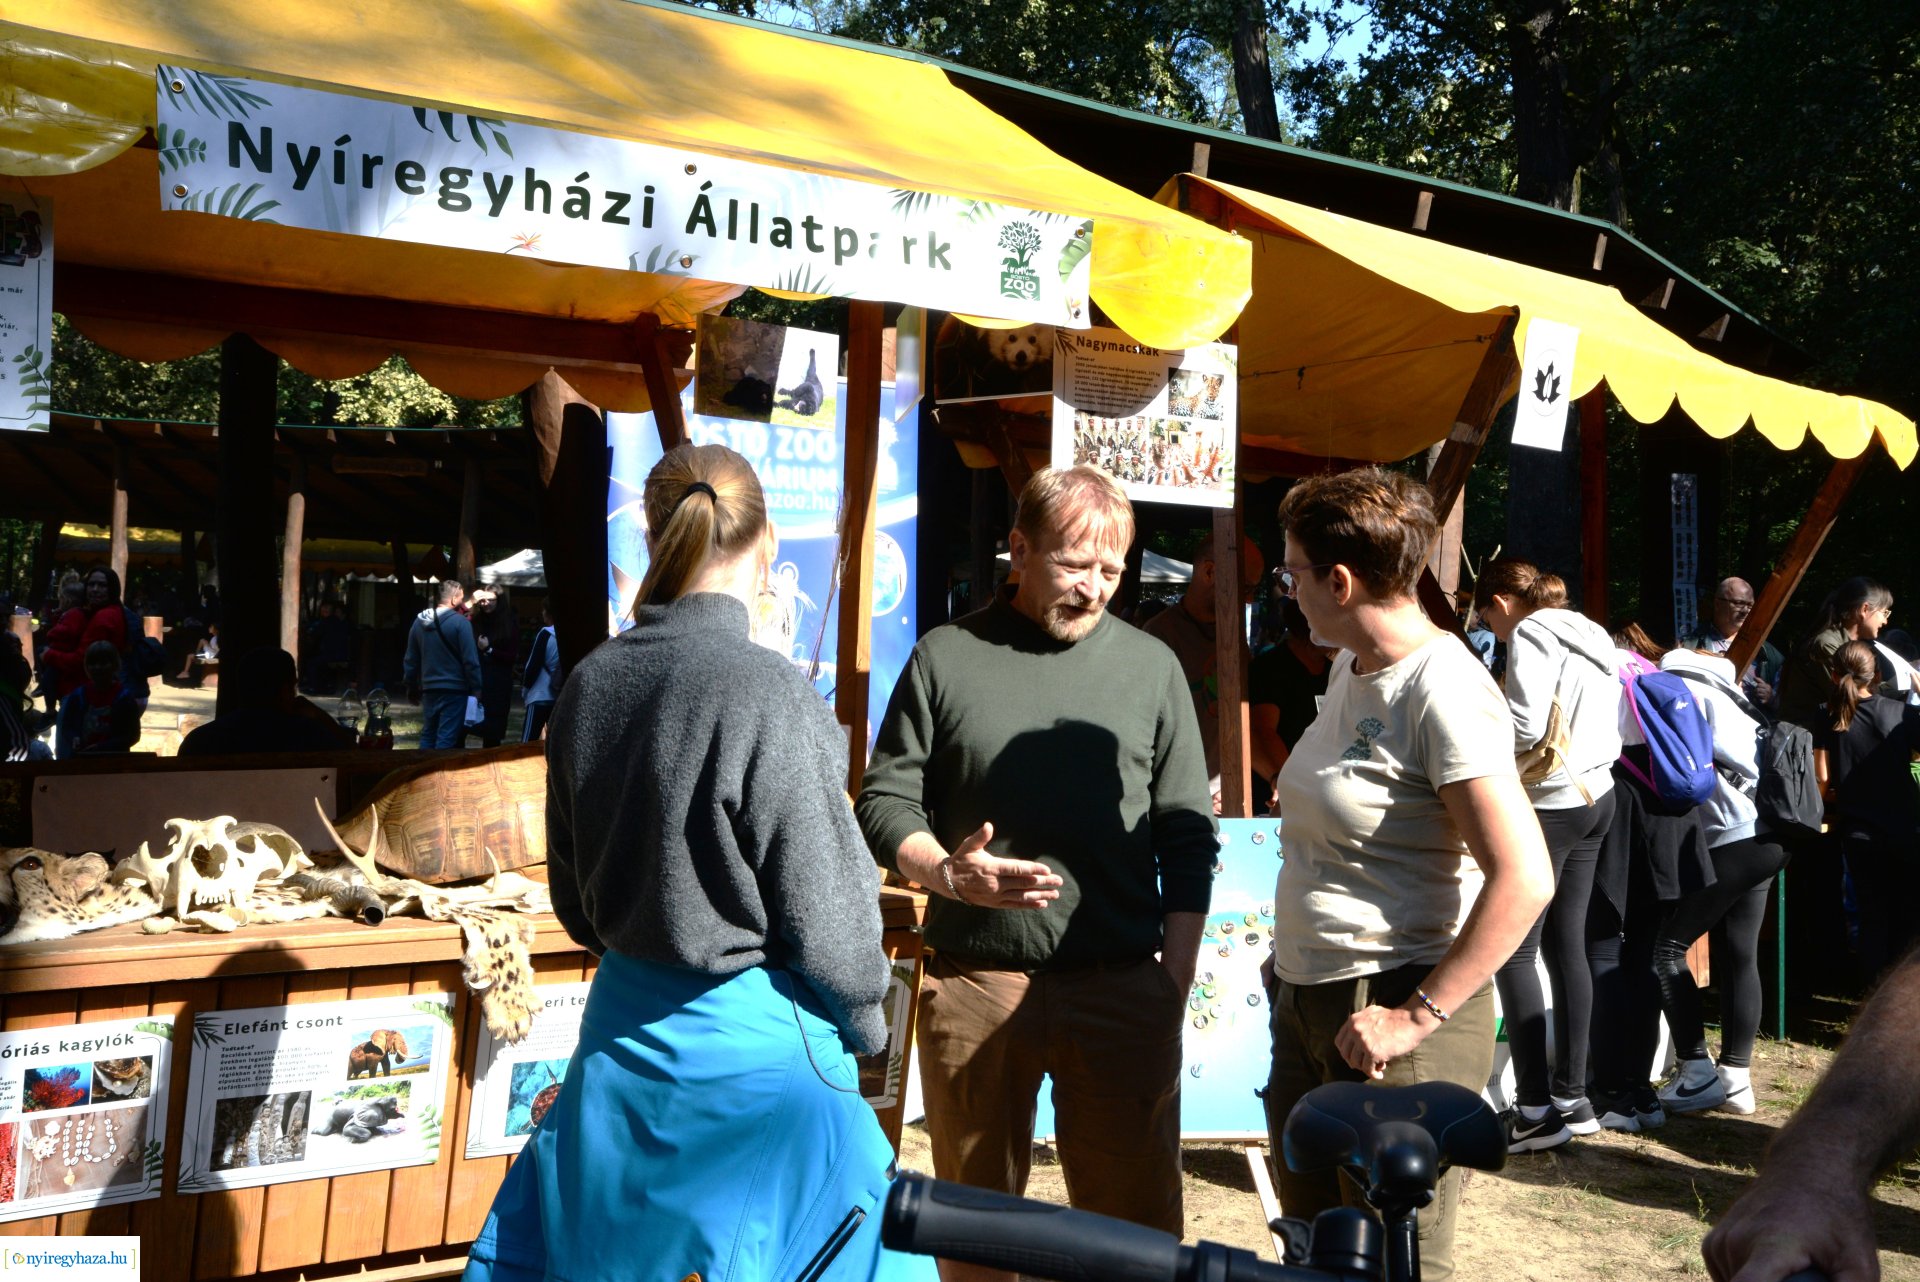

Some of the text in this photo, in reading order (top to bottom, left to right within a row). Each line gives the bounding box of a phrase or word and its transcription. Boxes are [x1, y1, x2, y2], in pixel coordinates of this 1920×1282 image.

[228, 121, 656, 229] Nyíregyházi
[8, 286, 24, 294] már
[1004, 278, 1036, 292] ZOO
[775, 428, 837, 463] ZOO
[750, 457, 838, 492] ÁRIUM
[224, 1016, 344, 1036] Elefánt csont
[2, 1034, 134, 1058] óriás kagylók
